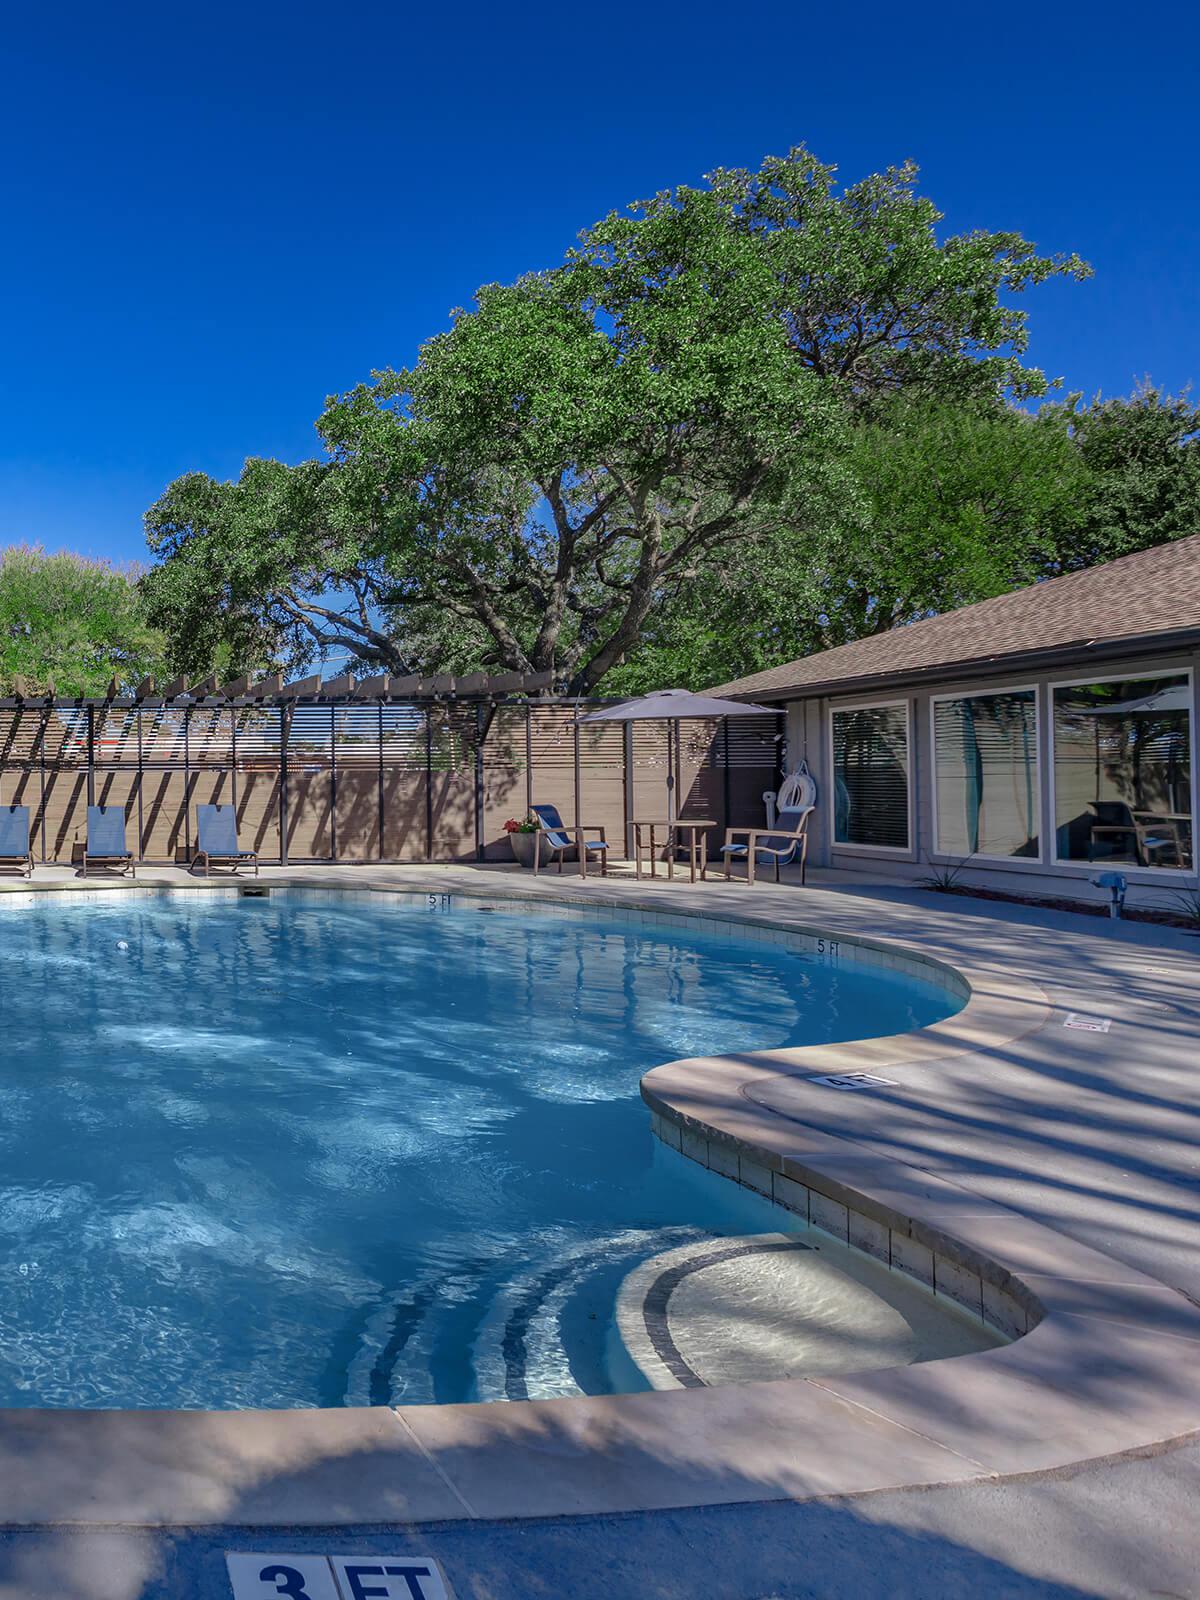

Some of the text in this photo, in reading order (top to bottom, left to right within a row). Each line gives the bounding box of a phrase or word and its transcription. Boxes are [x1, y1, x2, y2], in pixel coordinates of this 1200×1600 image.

[429, 894, 451, 905] 5 FT
[817, 939, 840, 957] 5 FT
[825, 1074, 889, 1087] 4 FT
[259, 1564, 431, 1600] 3 FT
